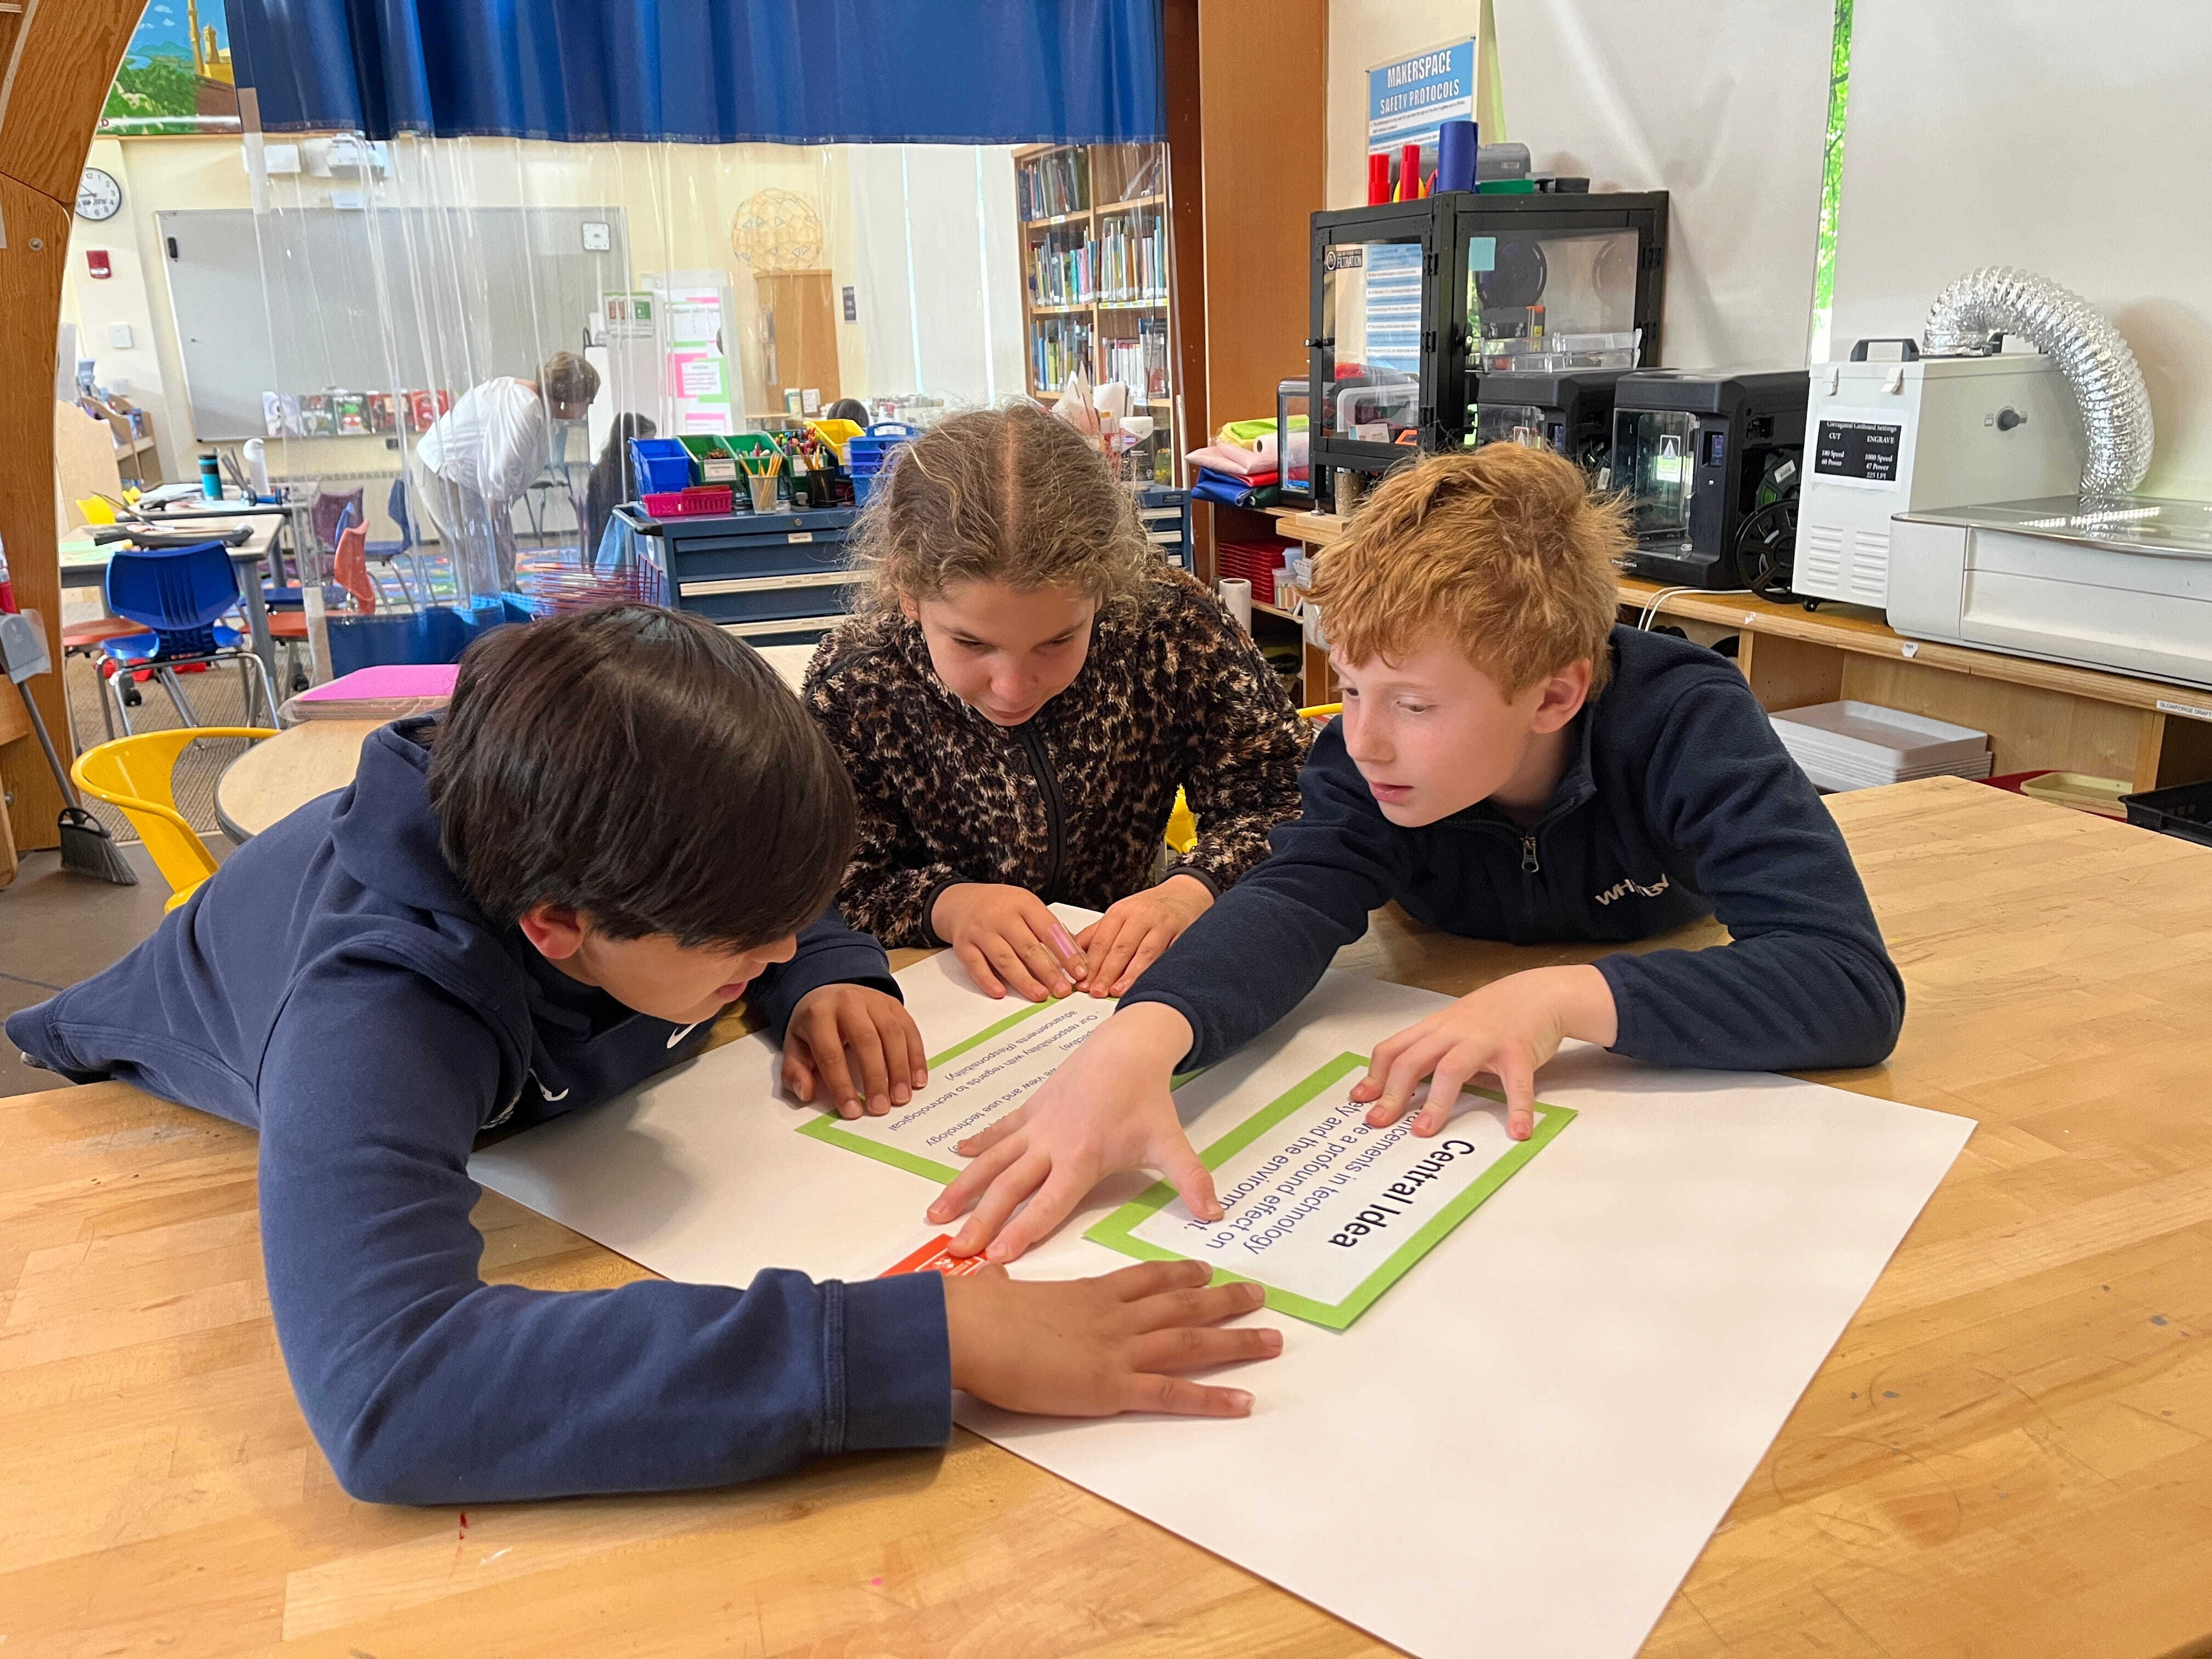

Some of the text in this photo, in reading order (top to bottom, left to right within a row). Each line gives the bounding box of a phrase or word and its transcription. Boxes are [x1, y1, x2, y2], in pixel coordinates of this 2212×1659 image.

[1387, 50, 1452, 88] MAKERSPACE
[1380, 93, 1408, 115] SAFETY
[1409, 78, 1460, 107] PROTOCOLS
[1337, 255, 1362, 268] FILTRATION
[1829, 432, 1841, 441] CUT
[1866, 435, 1895, 444] ENGRAVE
[1830, 450, 1844, 459] Speed
[1877, 454, 1893, 463] Speed
[2159, 702, 2193, 714] GLOWFORGE
[1079, 1014, 1098, 1025] Our
[944, 1011, 1078, 1081] advancements (Responsibility)
[1022, 1023, 1080, 1055] responsibility
[1003, 1054, 1025, 1066] with
[966, 1065, 1005, 1086] regards
[1022, 1076, 1046, 1090] view
[1001, 1087, 1023, 1101] and
[888, 1092, 958, 1131] technological
[982, 1100, 1003, 1114] use
[926, 1112, 986, 1147] technology
[1308, 1117, 1342, 1138] and
[1285, 1136, 1319, 1155] the
[1339, 1135, 1358, 1144] a
[1276, 1142, 1345, 1195] profound
[1328, 1173, 1356, 1185] in
[1183, 1155, 1289, 1231] environmnt.
[1327, 1140, 1476, 1248] Central Idea
[1229, 1195, 1281, 1231] effect
[1243, 1186, 1340, 1255] technology
[1206, 1232, 1235, 1249] on
